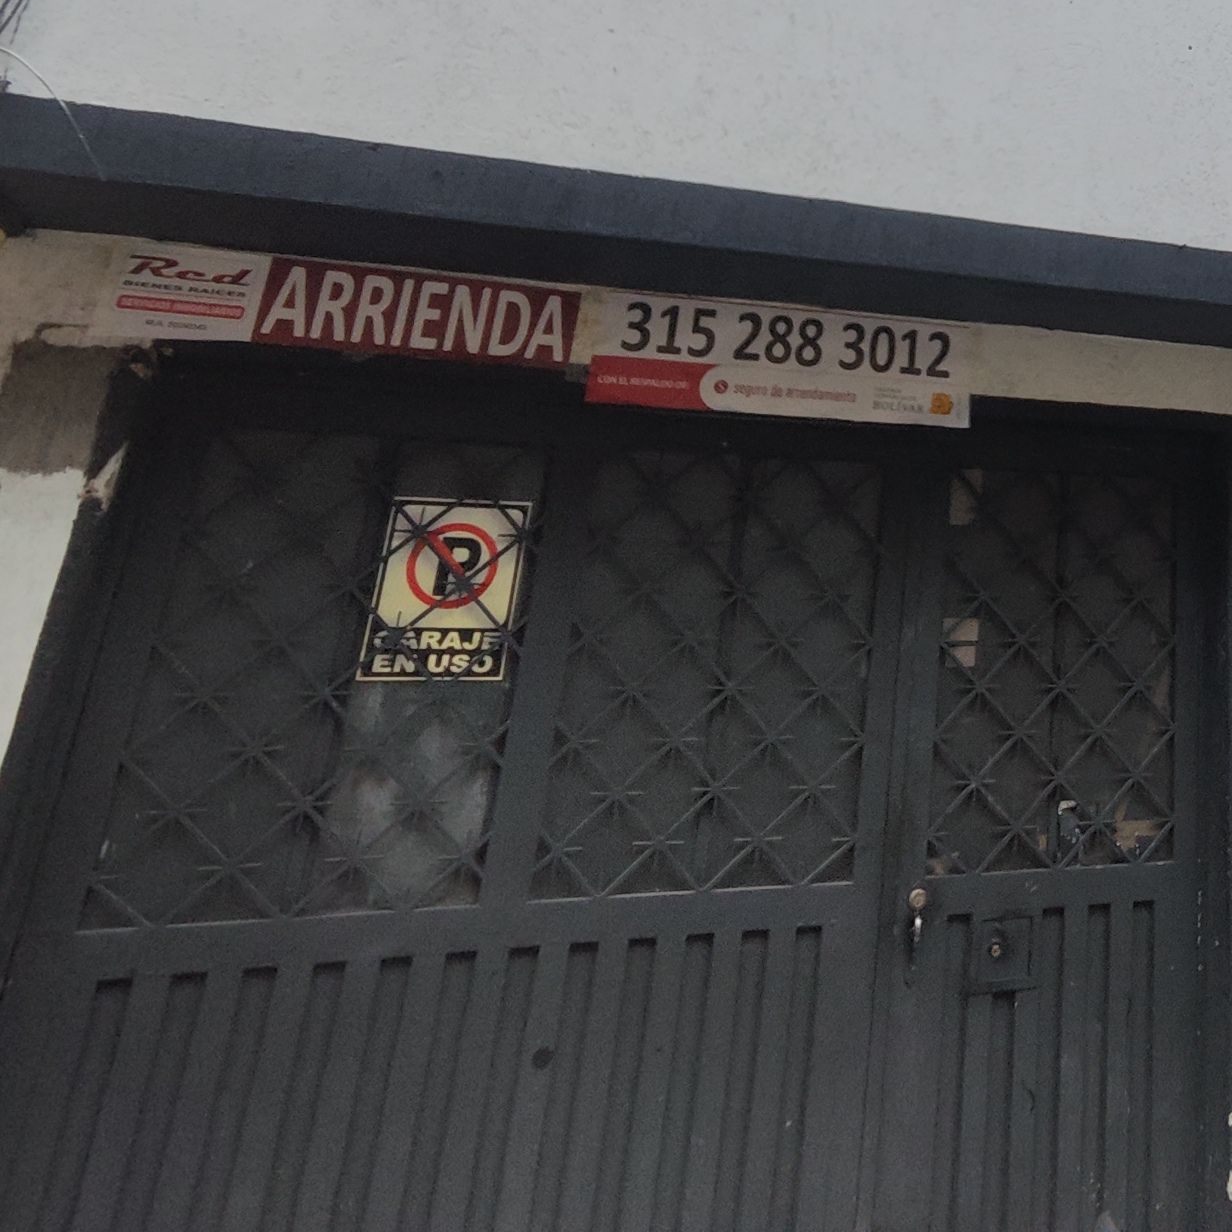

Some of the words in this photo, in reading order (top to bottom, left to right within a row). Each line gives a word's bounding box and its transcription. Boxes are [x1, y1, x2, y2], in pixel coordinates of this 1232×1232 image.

[122, 279, 183, 293] BIENES
[260, 265, 566, 364] ARRIENDA
[619, 300, 718, 358] 315
[731, 310, 824, 367] 288
[837, 321, 952, 379] 3012
[733, 382, 768, 399] seguro
[770, 383, 783, 398] de
[371, 653, 418, 673] EN
[427, 653, 494, 673] USO
